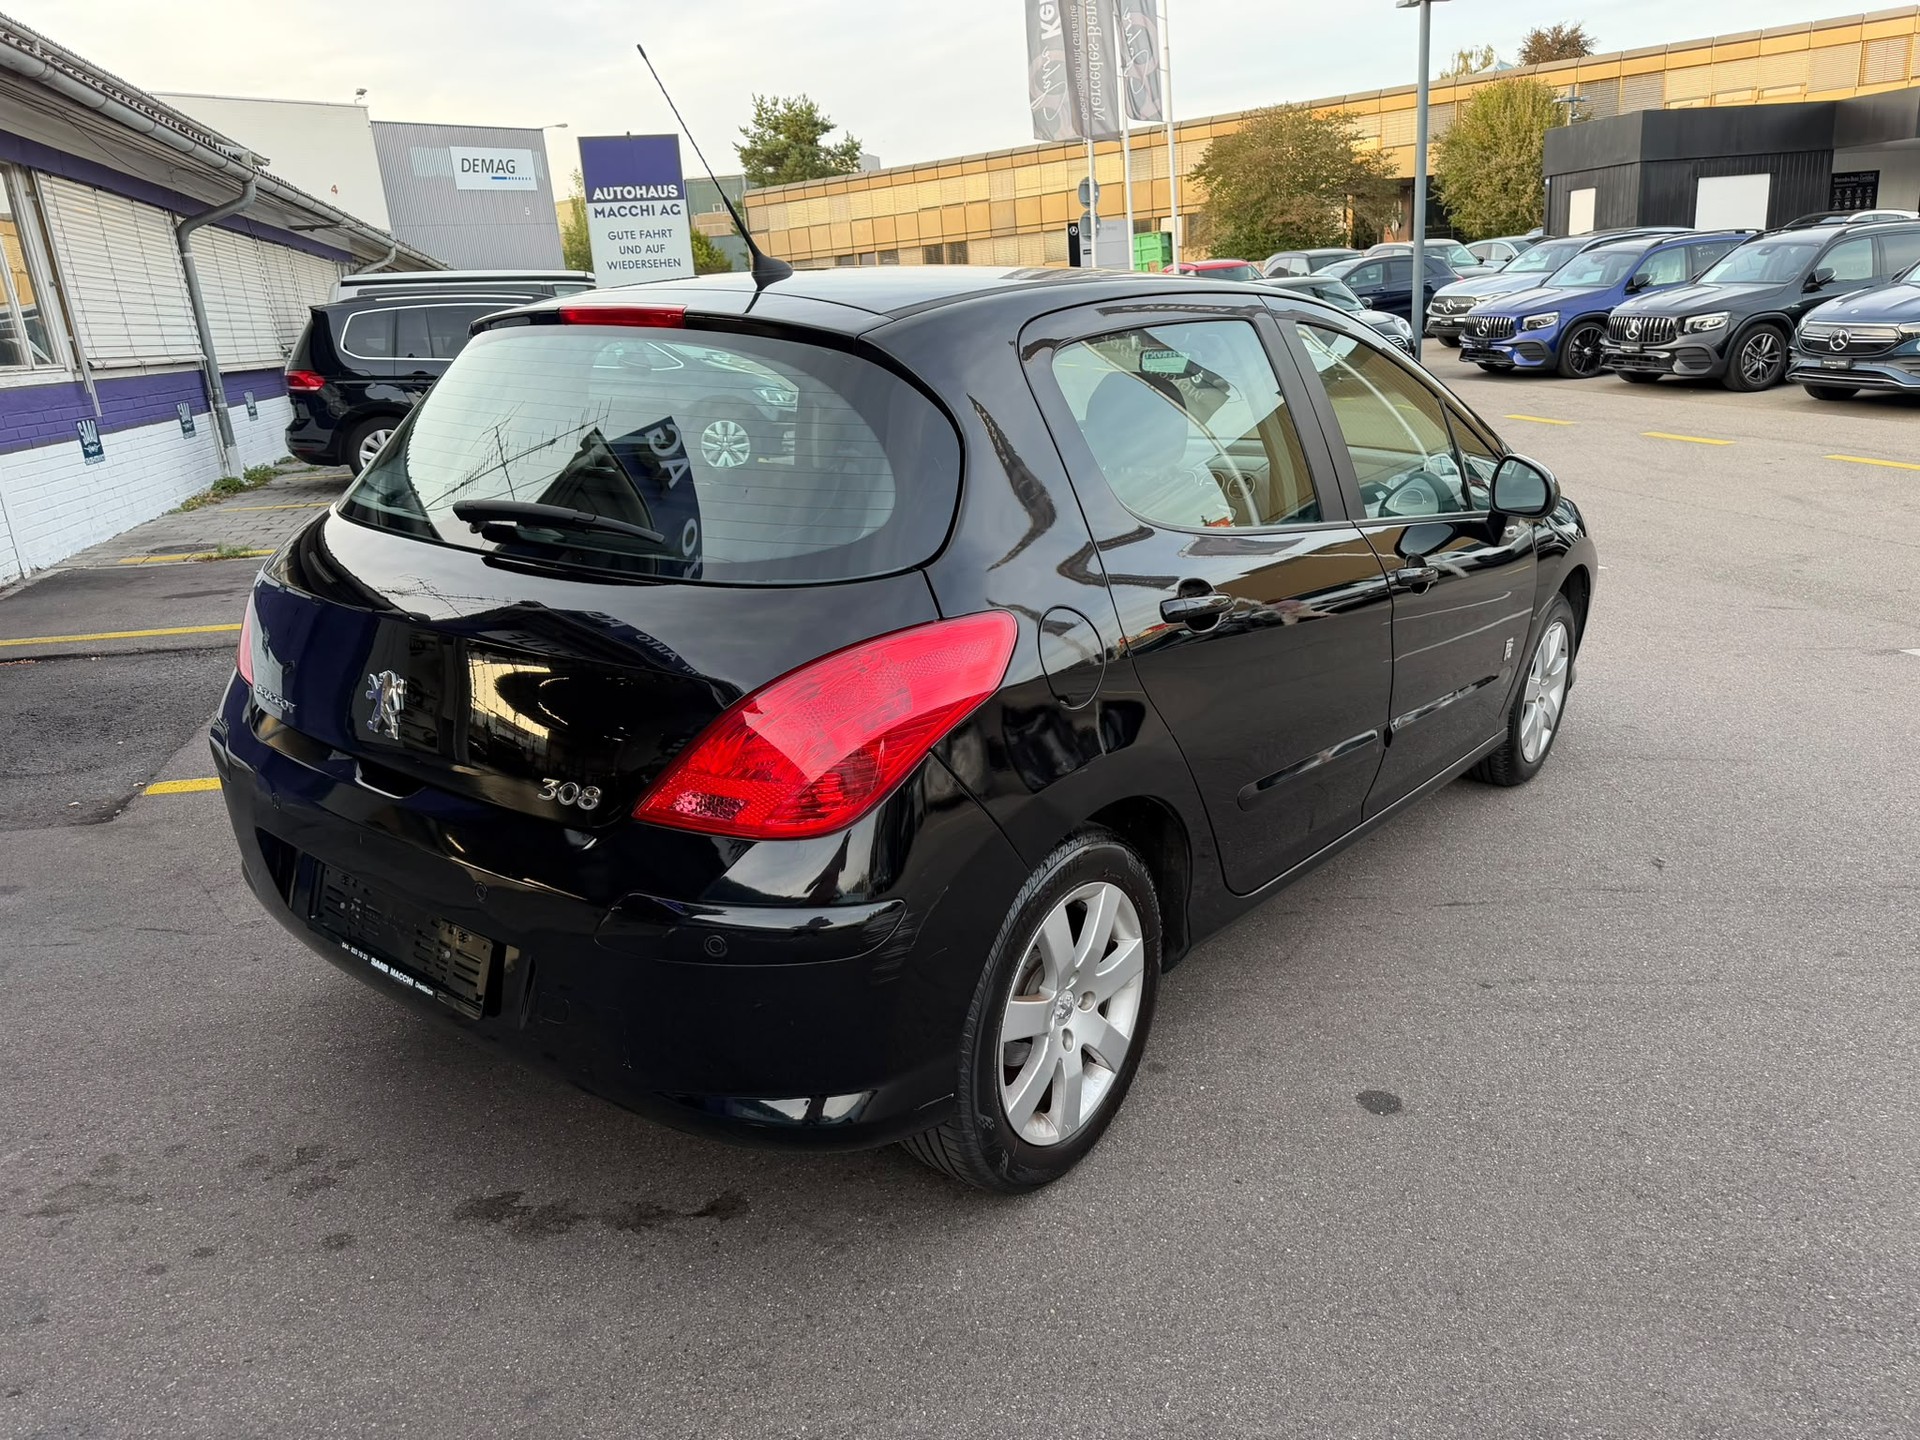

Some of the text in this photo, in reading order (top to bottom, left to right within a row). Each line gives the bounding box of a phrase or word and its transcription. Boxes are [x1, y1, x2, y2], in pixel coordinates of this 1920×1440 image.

[461, 157, 516, 174] DEMAG
[592, 184, 679, 200] AUTOHAUS
[593, 203, 681, 218] MACCHI AG
[607, 229, 673, 240] GUTE FAHRT
[619, 244, 666, 255] UND AUF
[606, 258, 681, 270] WIEDERSEHEN
[256, 685, 296, 713] PEUGEOT
[536, 777, 602, 811] 308
[370, 957, 389, 973] SAAB
[389, 967, 414, 986] MACCHI
